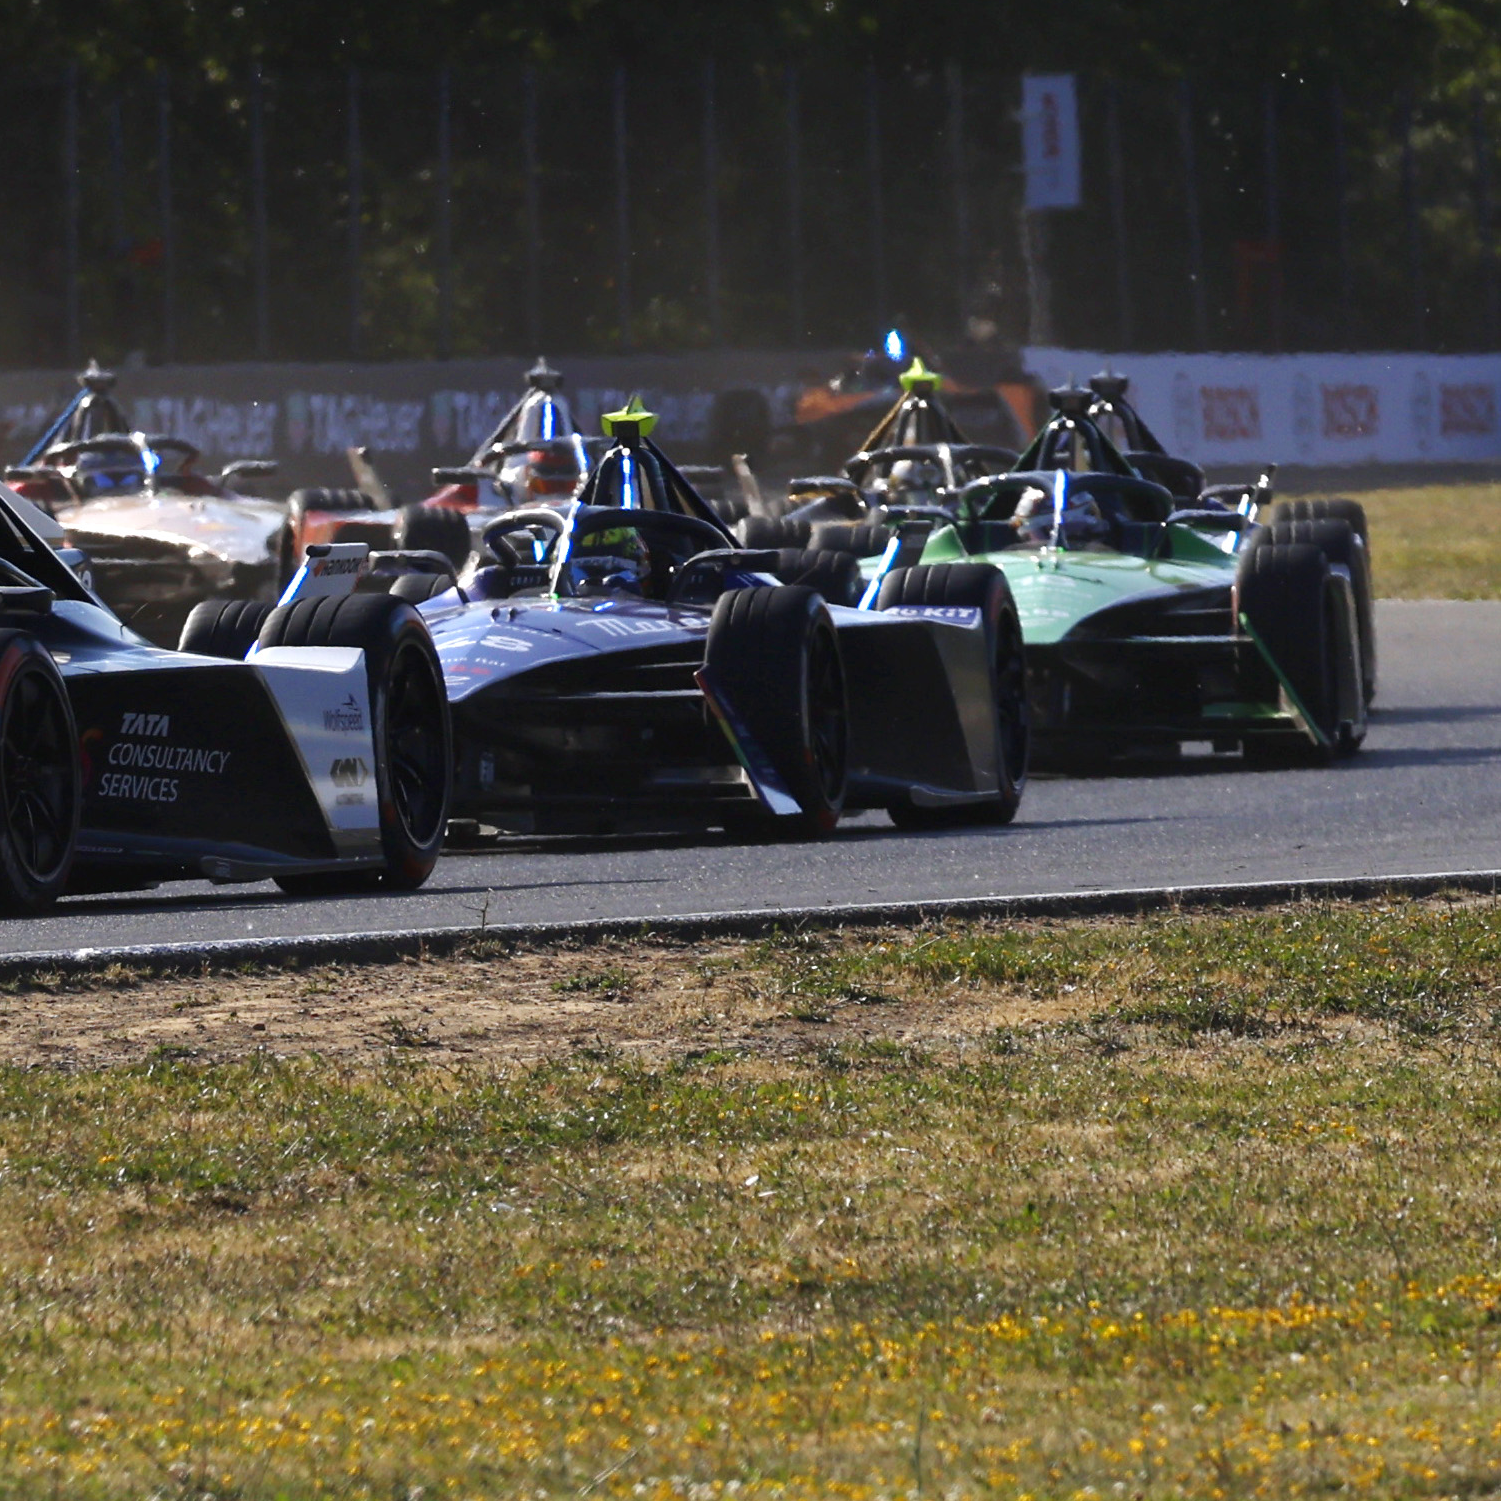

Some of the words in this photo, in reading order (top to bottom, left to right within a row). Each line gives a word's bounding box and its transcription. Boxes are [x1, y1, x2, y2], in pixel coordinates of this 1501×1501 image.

[119, 712, 171, 738] TATA
[108, 743, 232, 774] CONSULTANCY
[98, 772, 180, 802] SERVICES
